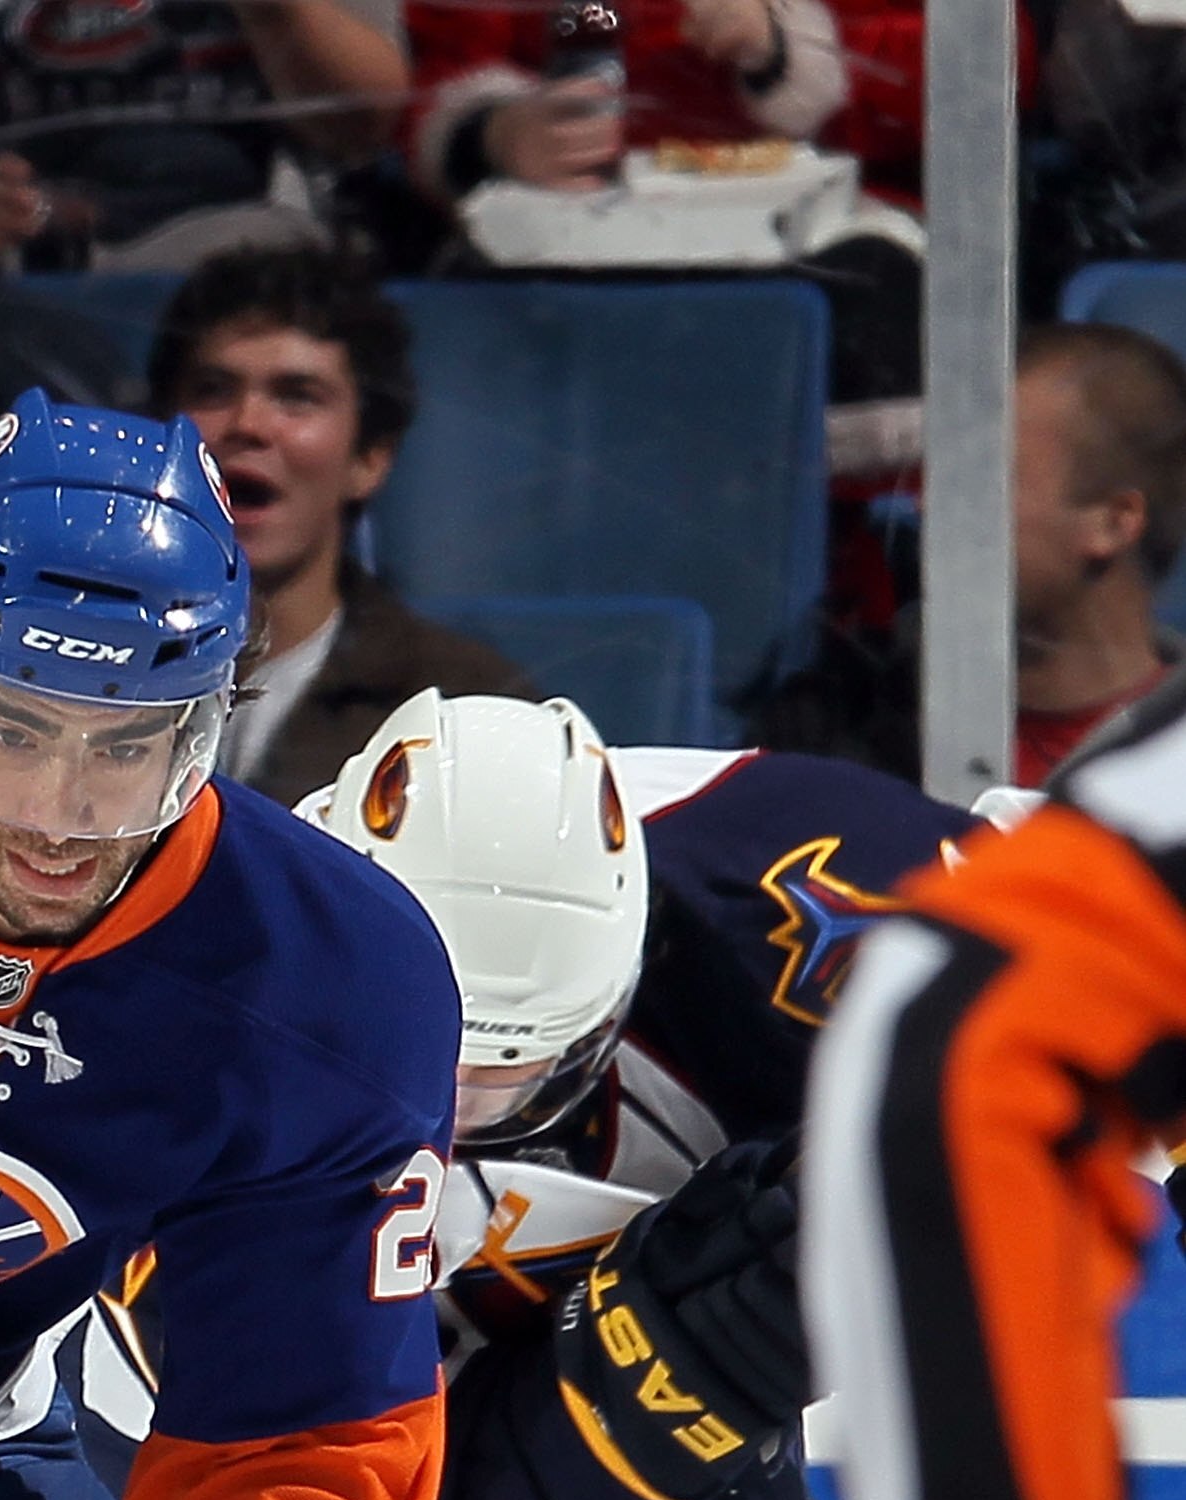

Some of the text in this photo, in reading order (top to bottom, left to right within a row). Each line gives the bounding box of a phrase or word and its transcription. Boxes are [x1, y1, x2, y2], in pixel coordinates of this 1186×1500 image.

[21, 626, 135, 665] CCM
[463, 1019, 537, 1036] AUER
[371, 1145, 447, 1301] 2
[589, 1264, 745, 1463] EAST
